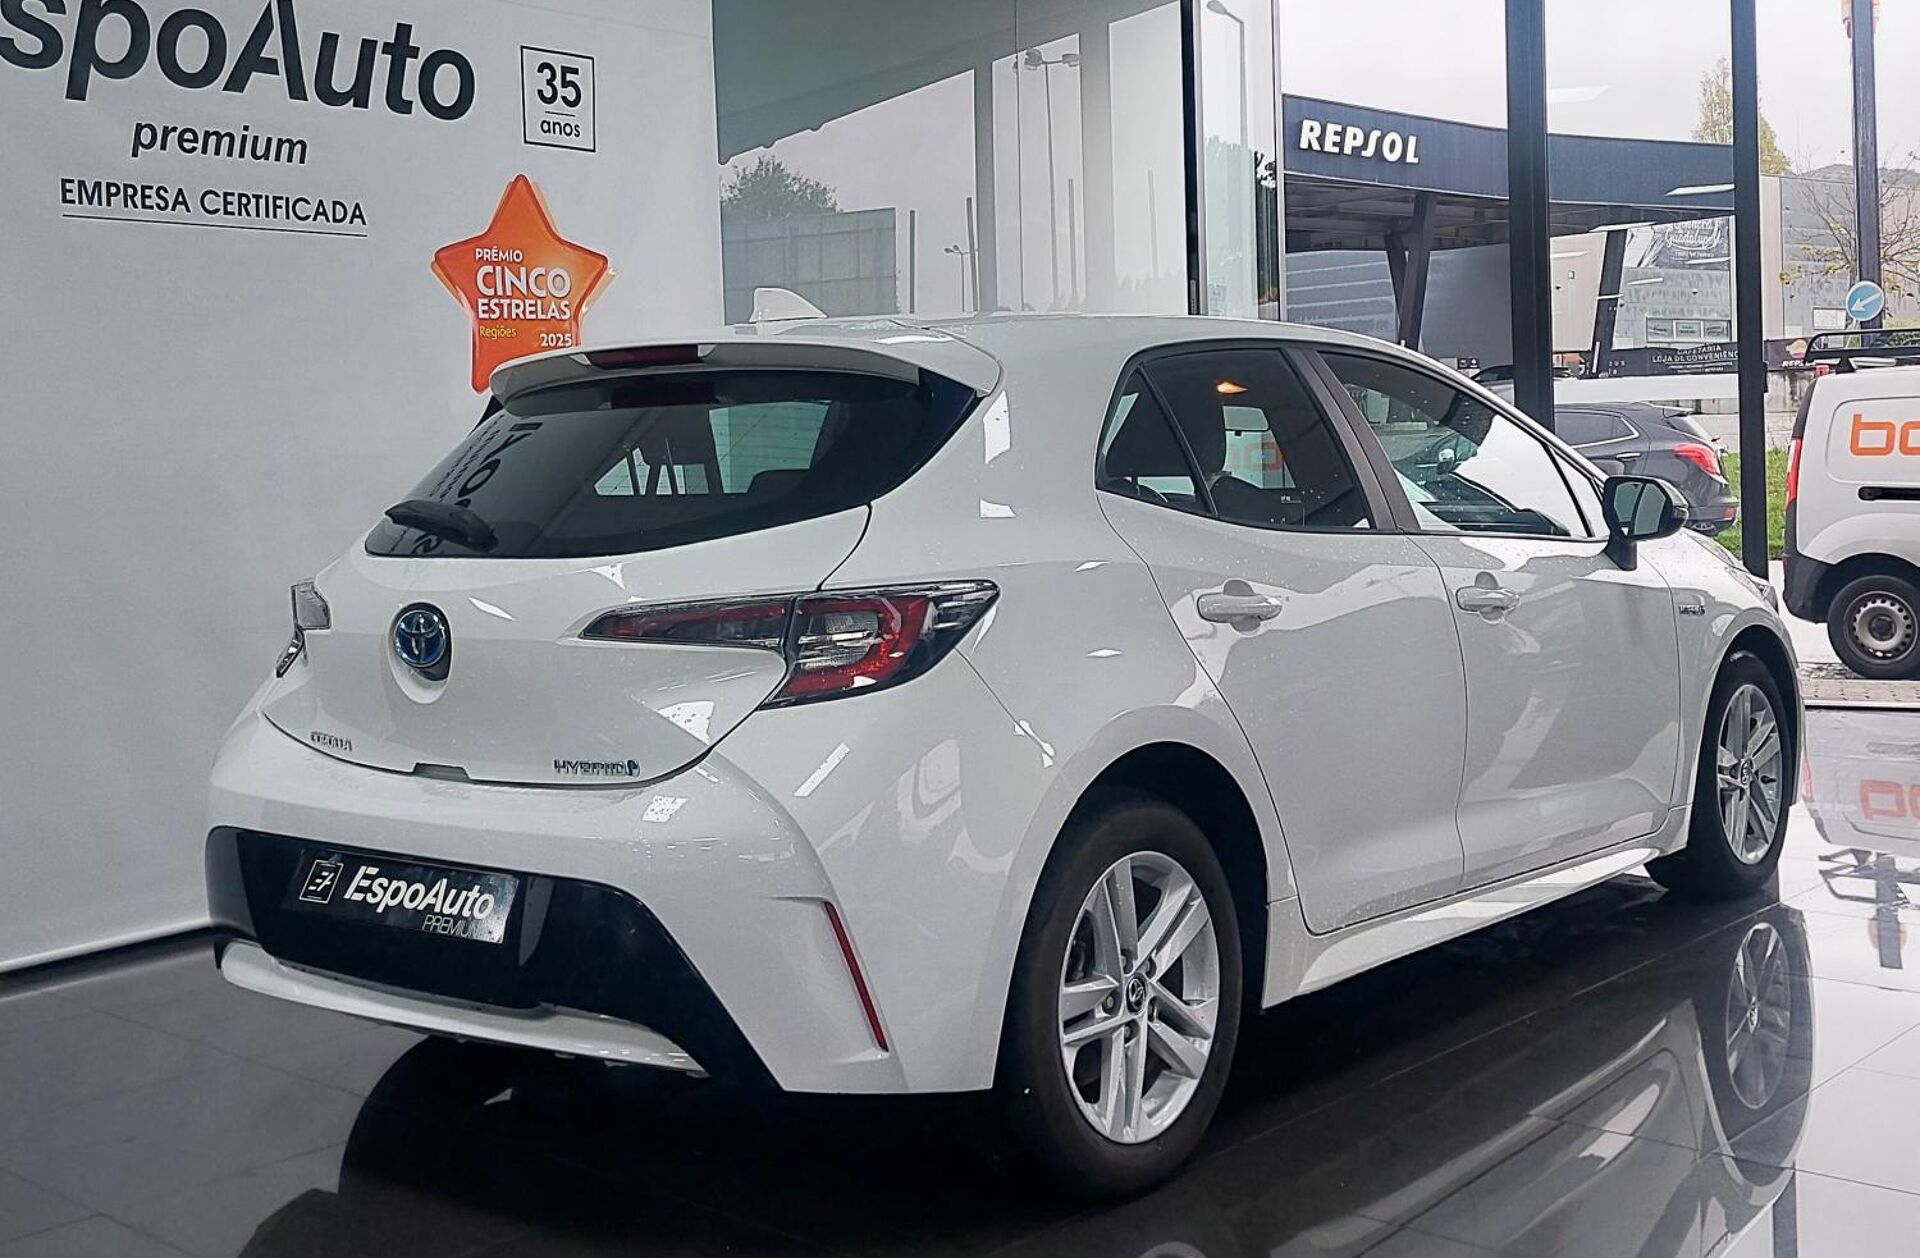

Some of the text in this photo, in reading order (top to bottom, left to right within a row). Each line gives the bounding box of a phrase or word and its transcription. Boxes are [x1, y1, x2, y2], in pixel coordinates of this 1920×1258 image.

[536, 61, 582, 109] 35
[131, 120, 309, 165] premium
[540, 119, 581, 138] anos
[1300, 118, 1420, 164] REPSOL
[60, 177, 368, 226] EMPRESA CERTIFICADA
[475, 246, 523, 262] PRÉMIO
[476, 265, 572, 298] CINCO
[477, 298, 571, 320] ESTRELAS
[479, 325, 517, 340] Regiões
[539, 333, 573, 347] 2025
[344, 865, 495, 919] EspoAuto
